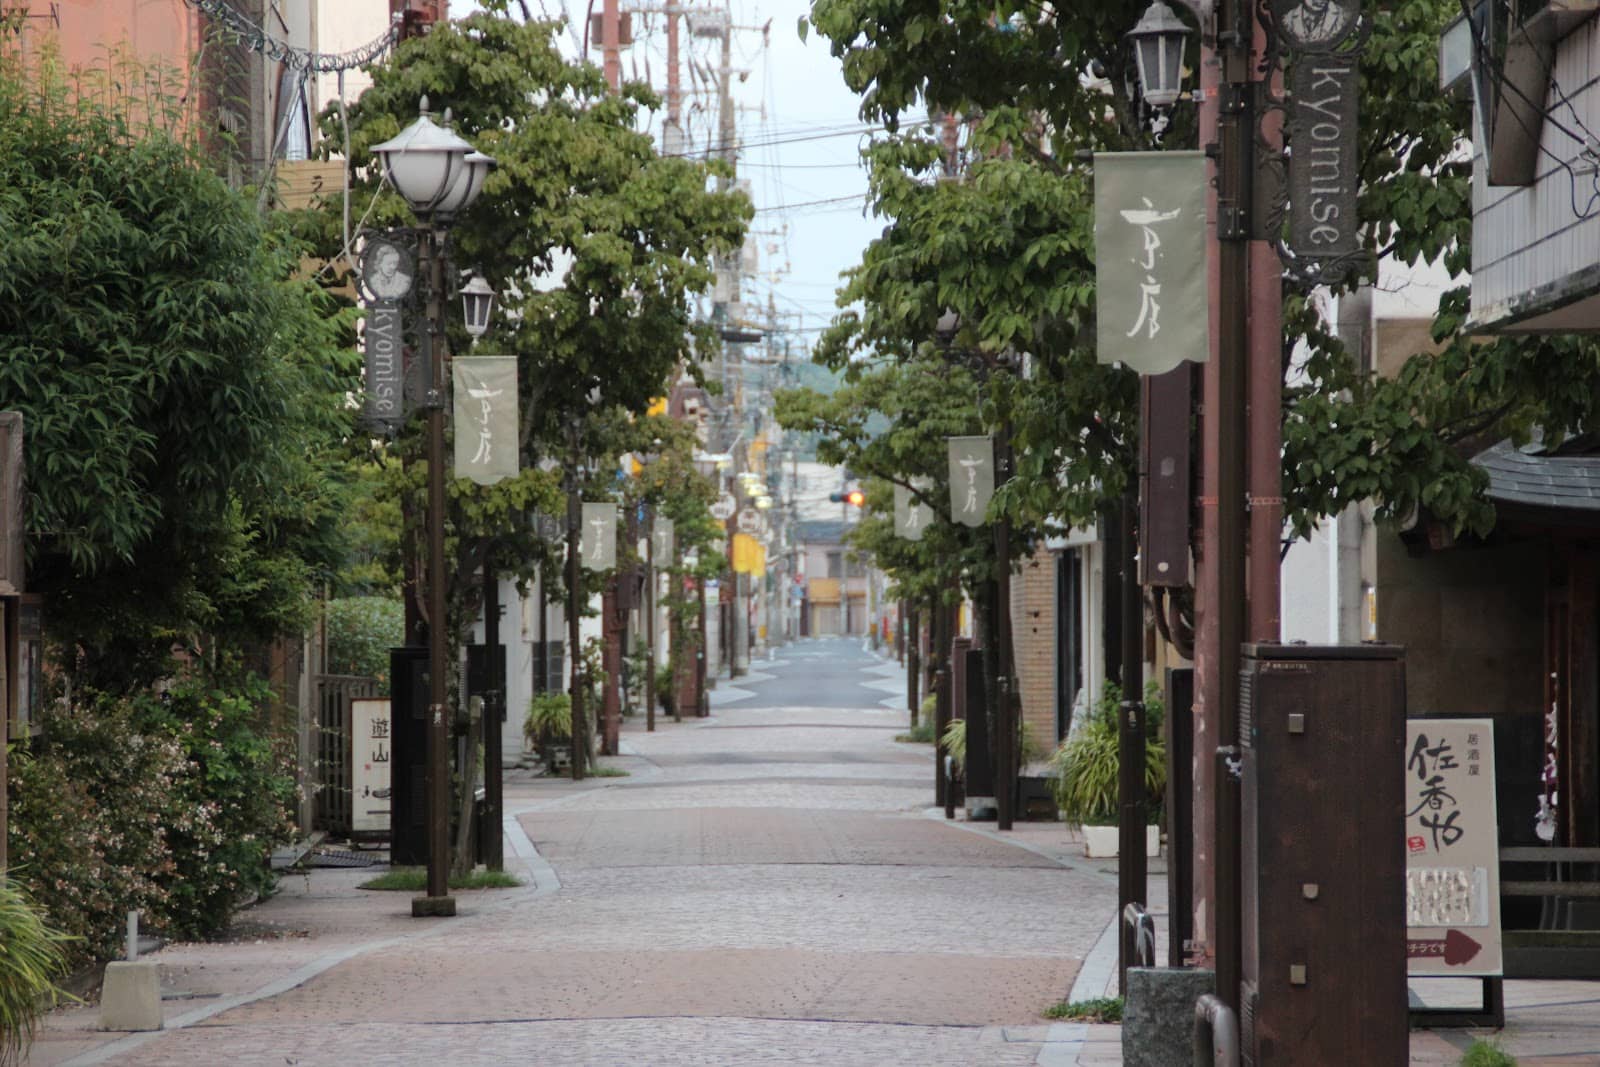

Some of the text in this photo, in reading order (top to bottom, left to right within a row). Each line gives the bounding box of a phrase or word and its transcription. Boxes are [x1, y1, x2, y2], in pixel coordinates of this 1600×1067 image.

[1299, 67, 1350, 245] kyomise
[1119, 196, 1182, 339] 京店
[367, 307, 398, 411] kyomise
[468, 381, 503, 465] 京店
[371, 718, 389, 763] 遊山
[1467, 733, 1480, 776] 居酒屋
[1406, 733, 1464, 853] 佐香や
